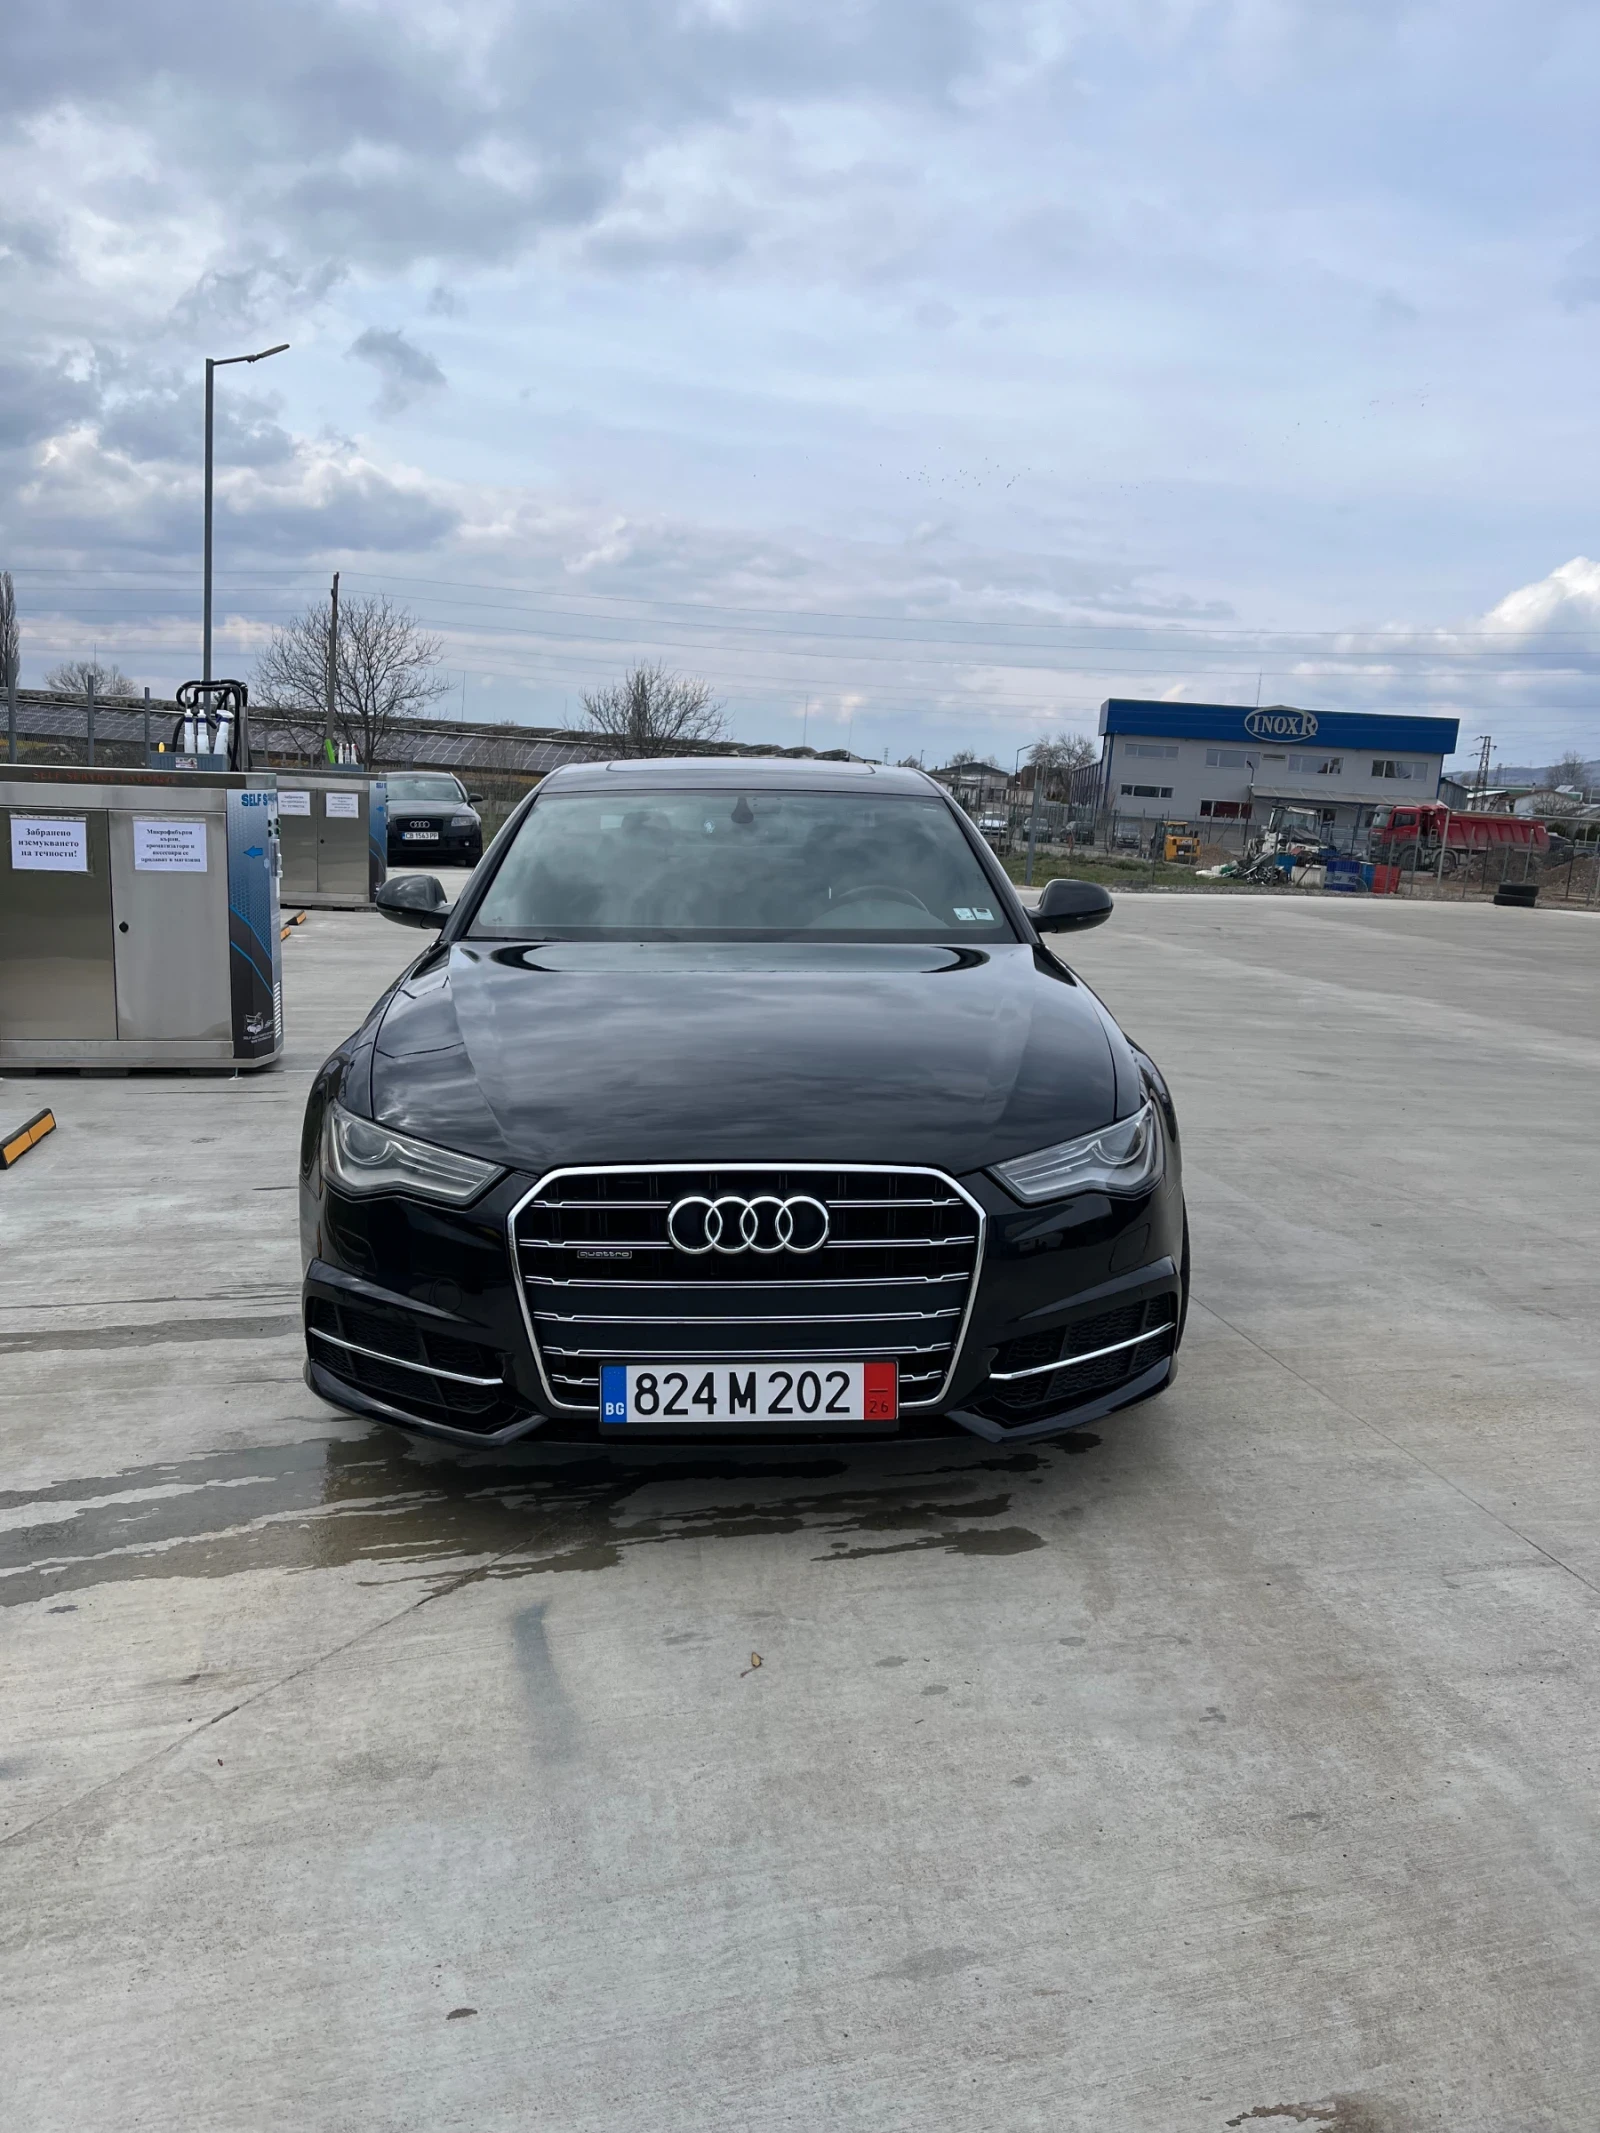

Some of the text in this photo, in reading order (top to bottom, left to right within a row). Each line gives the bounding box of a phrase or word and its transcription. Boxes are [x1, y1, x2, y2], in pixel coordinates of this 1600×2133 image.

[241, 793, 261, 806] SELF
[25, 828, 71, 837] Забранено
[579, 1250, 630, 1258] quattro
[634, 1371, 851, 1416] 824 M 202
[605, 1402, 625, 1416] BG
[868, 1400, 889, 1413] 26
